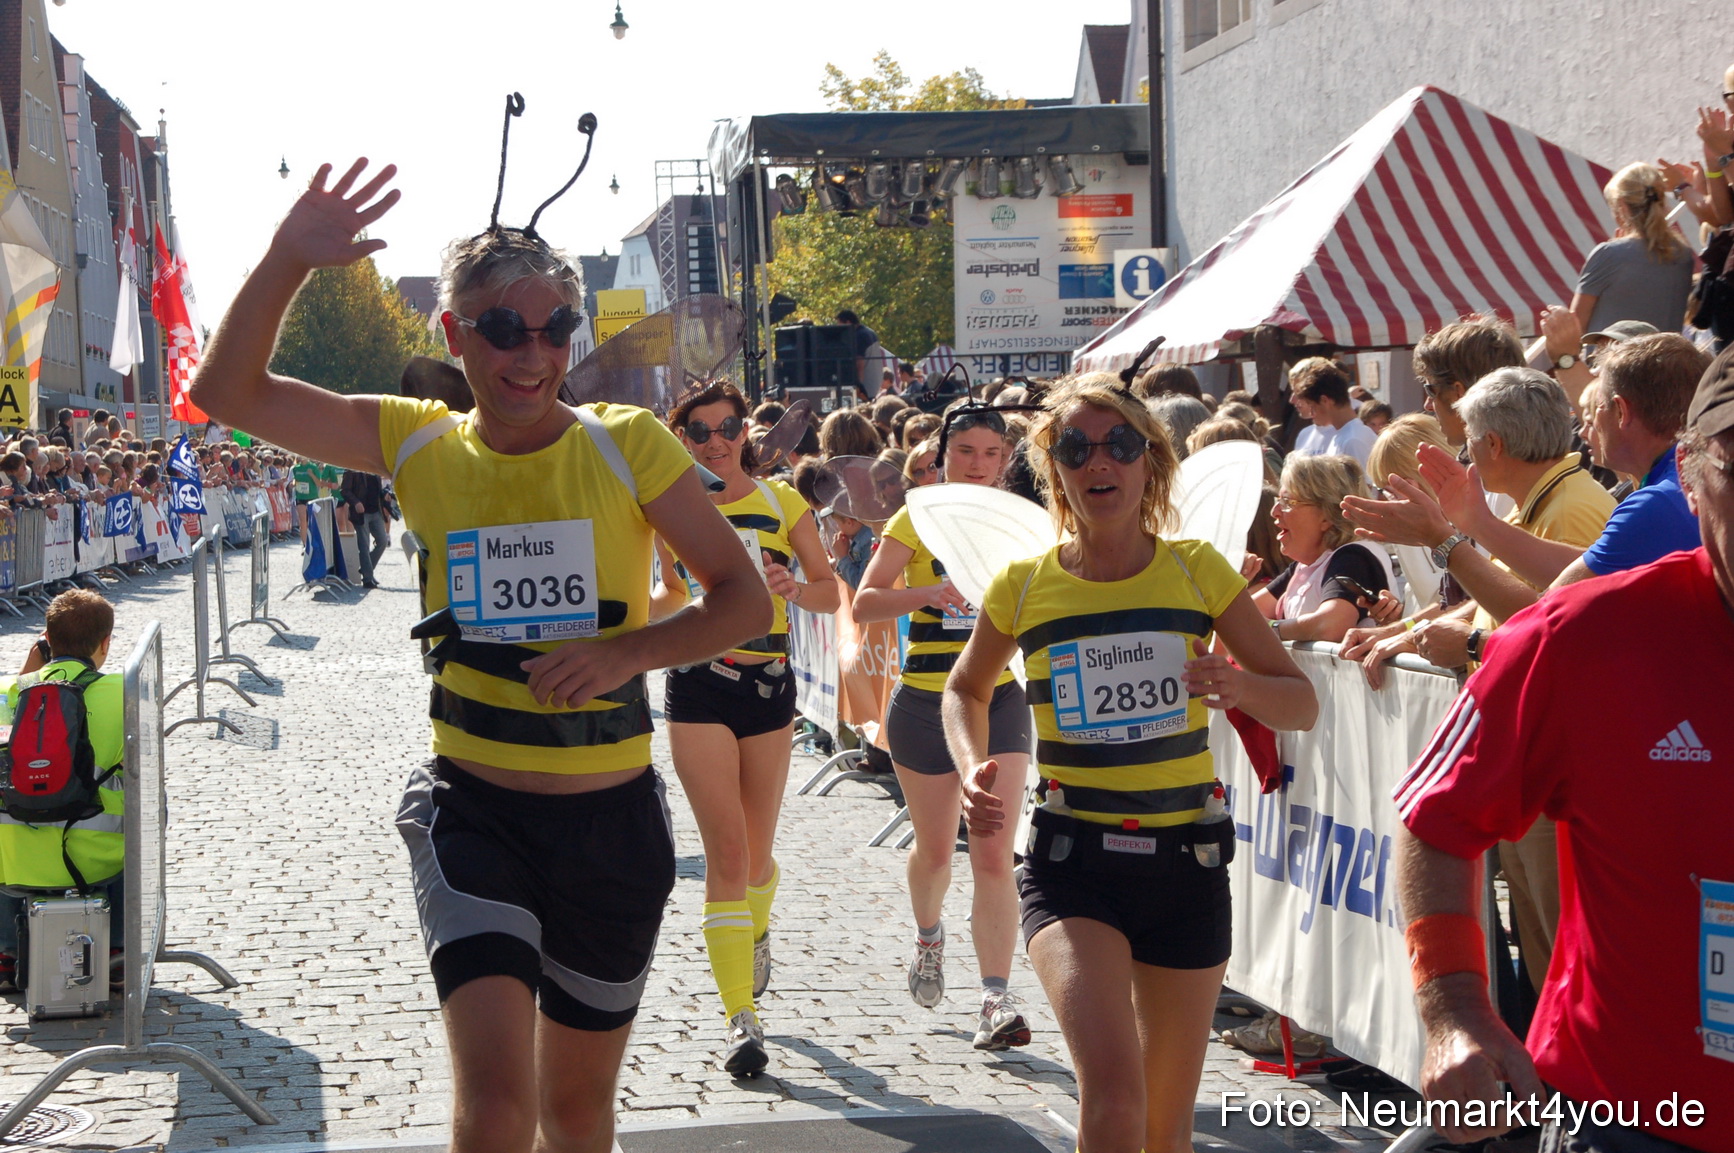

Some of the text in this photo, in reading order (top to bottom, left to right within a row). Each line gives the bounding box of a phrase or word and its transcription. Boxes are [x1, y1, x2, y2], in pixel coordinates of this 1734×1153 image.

[999, 241, 1036, 249] Neumarkter
[1060, 244, 1095, 254] Wagner
[966, 258, 1040, 277] Pröbster
[967, 315, 1038, 329] FISCHER
[1061, 317, 1120, 326] NTERSPORT
[0, 369, 24, 380] lock
[0, 384, 20, 413] A
[486, 535, 555, 560] Markus
[454, 575, 463, 591] C
[492, 573, 586, 610] 3036
[542, 620, 596, 633] PFLEIDERER
[1085, 642, 1154, 670] Siglinde
[711, 662, 740, 680] PERFEKTA
[1058, 684, 1067, 699] C
[1093, 677, 1179, 715] 2830
[1142, 715, 1186, 733] PFLEIDERER
[1649, 747, 1712, 762] adidas
[1107, 838, 1152, 850] PERFEKTA
[1711, 951, 1724, 975] D
